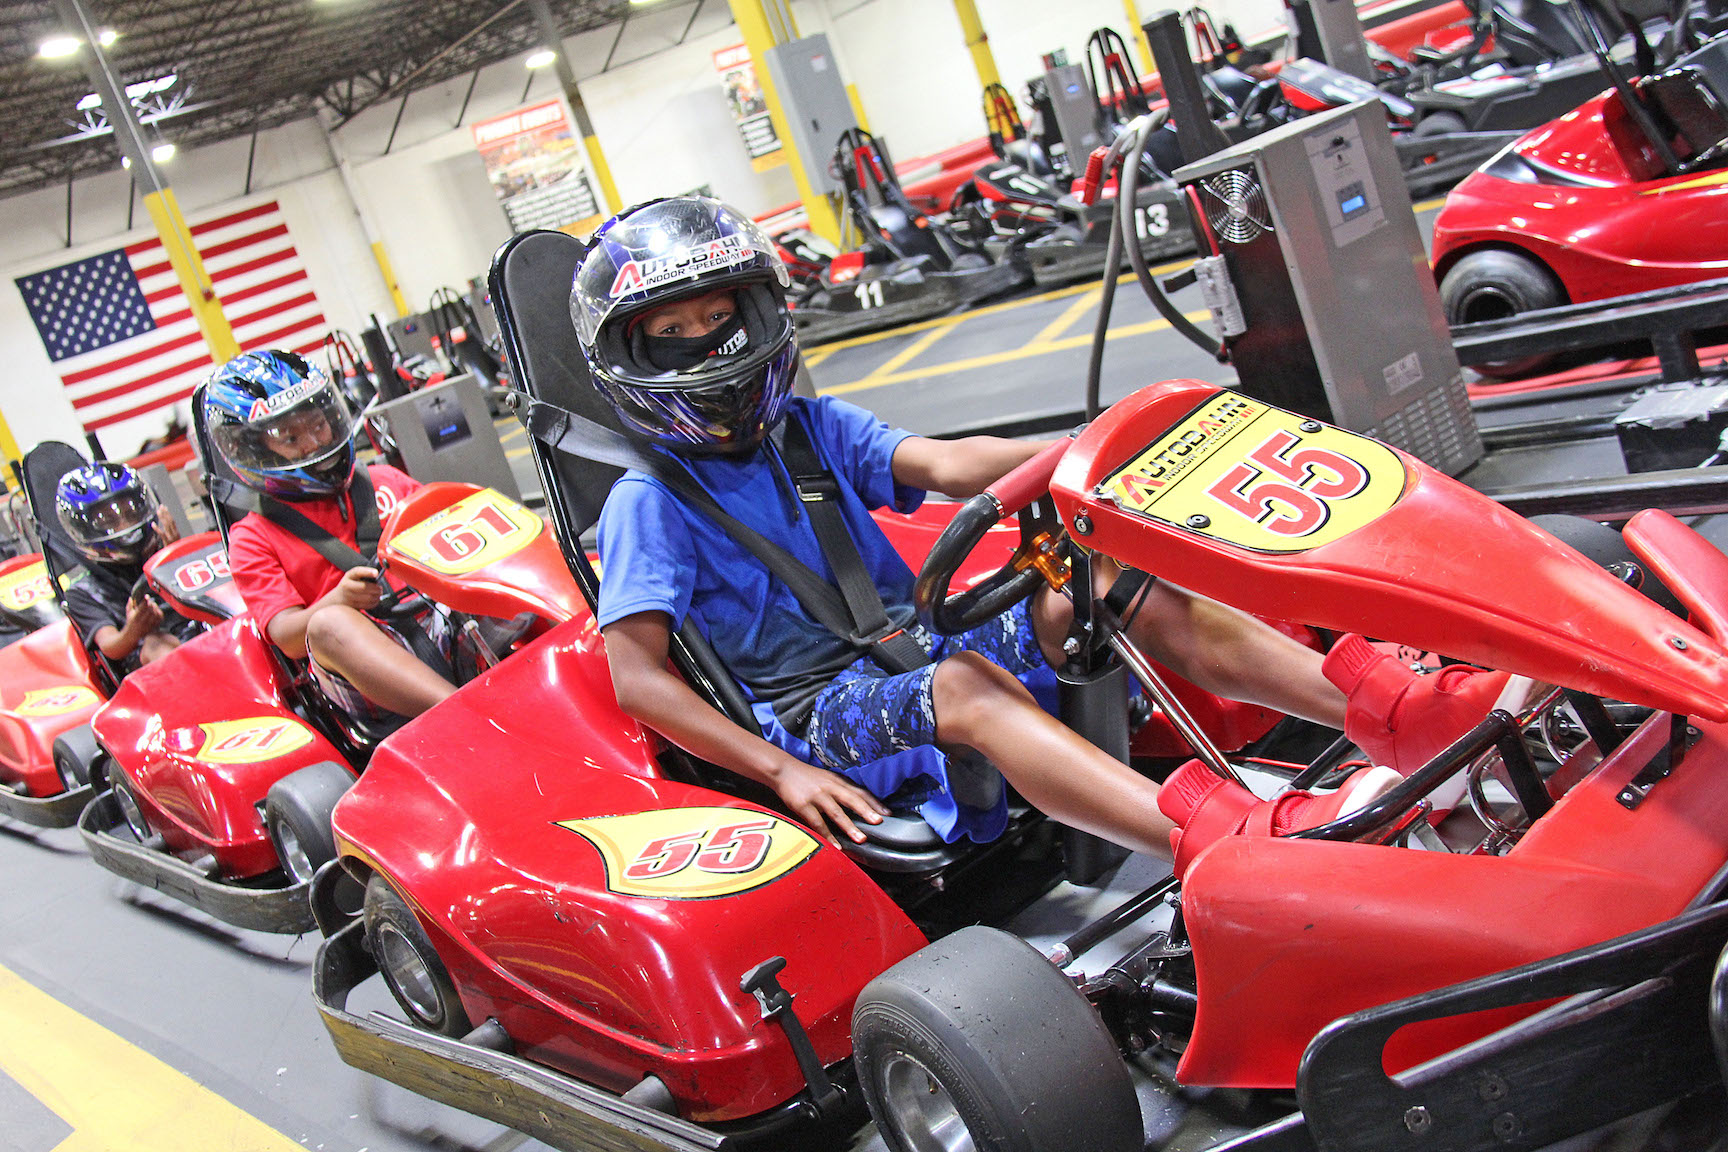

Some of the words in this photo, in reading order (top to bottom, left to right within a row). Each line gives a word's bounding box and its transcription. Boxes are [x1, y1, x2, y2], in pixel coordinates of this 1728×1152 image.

[1134, 203, 1169, 240] 13
[646, 268, 686, 285] INDOOR
[688, 252, 740, 273] SPEEDWAY
[854, 280, 884, 310] 11
[706, 326, 747, 356] UTOB
[251, 376, 320, 419] AUTOBA
[1121, 397, 1248, 505] AUTOBAHN
[1162, 452, 1197, 481] INDOOR
[1195, 416, 1242, 455] SPEEDWAY
[1202, 428, 1371, 538] 55
[425, 502, 520, 565] 61
[210, 721, 293, 752] 61
[1173, 763, 1219, 810] NIK
[623, 820, 778, 880] 55
